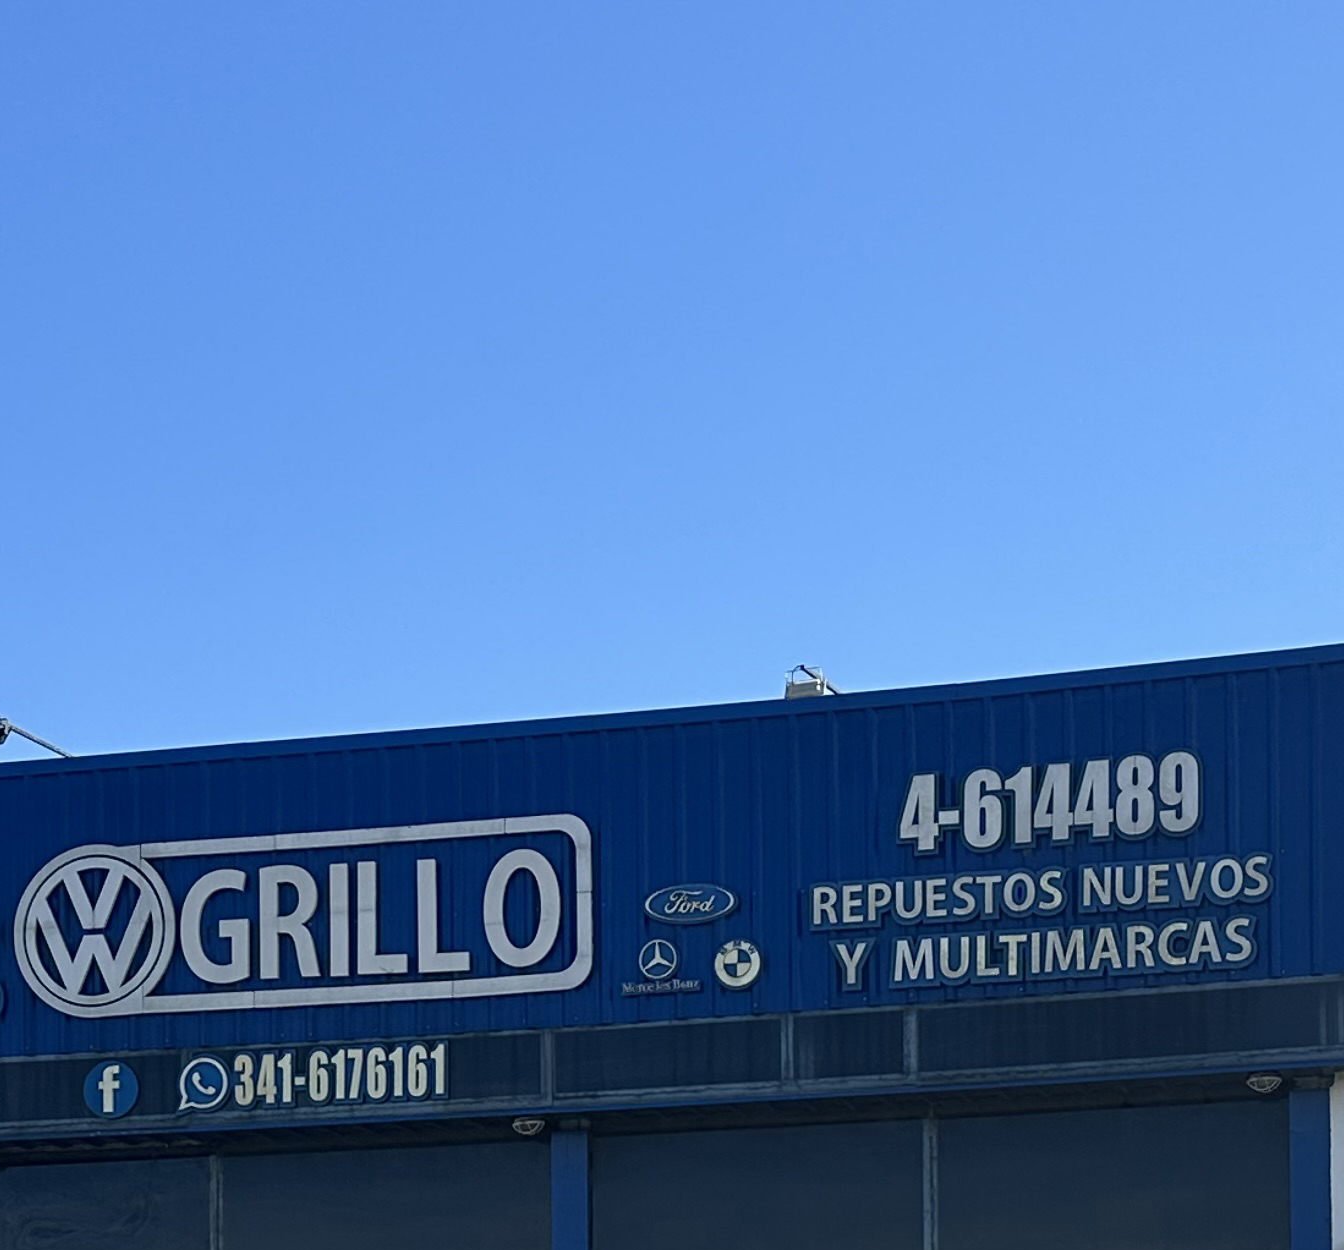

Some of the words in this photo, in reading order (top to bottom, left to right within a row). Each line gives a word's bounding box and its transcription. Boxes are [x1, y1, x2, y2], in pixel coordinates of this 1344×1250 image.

[900, 751, 1200, 850] 4-614489
[180, 848, 560, 984] GRILLO
[664, 890, 715, 915] Ford
[813, 870, 1063, 925] REPUESTOS
[1082, 855, 1269, 906] NUEVOS
[836, 943, 866, 986] Y
[893, 918, 1251, 983] MULTIMARCAS
[234, 1042, 445, 1106] 341-6176161
